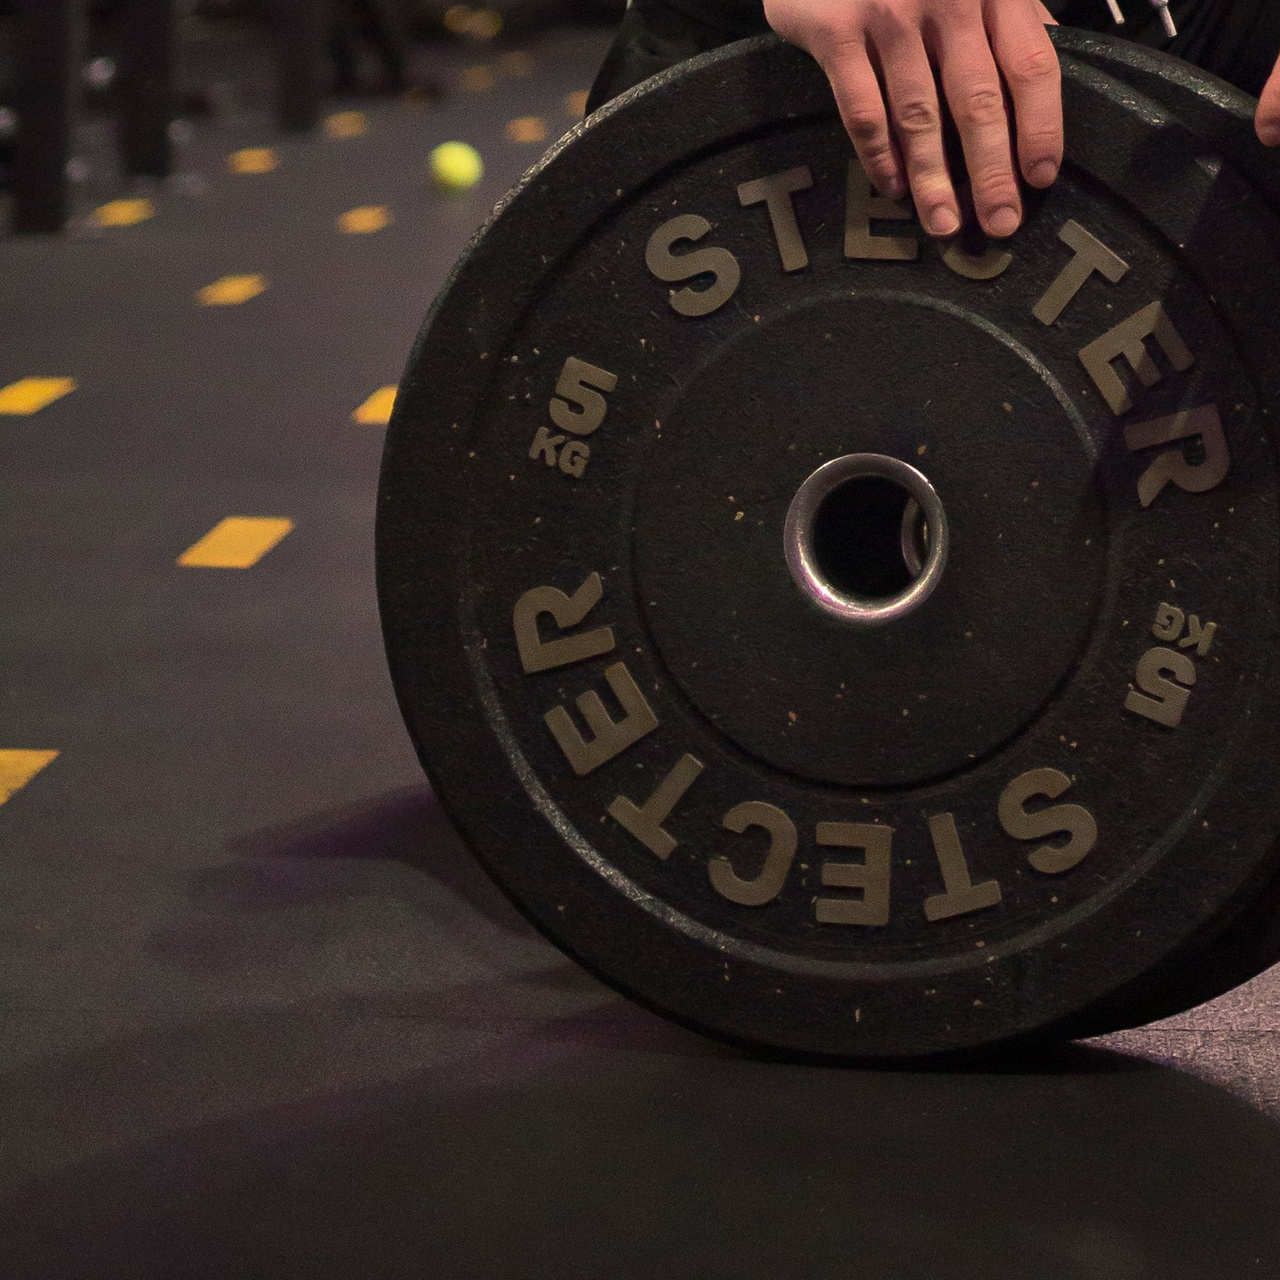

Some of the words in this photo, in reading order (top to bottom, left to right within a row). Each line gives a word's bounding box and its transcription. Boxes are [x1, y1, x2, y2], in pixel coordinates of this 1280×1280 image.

[549, 356, 619, 436] 5
[528, 425, 591, 479] KG
[1151, 602, 1218, 657] KG
[1124, 646, 1197, 728] 5
[513, 572, 1099, 928] STECTER
